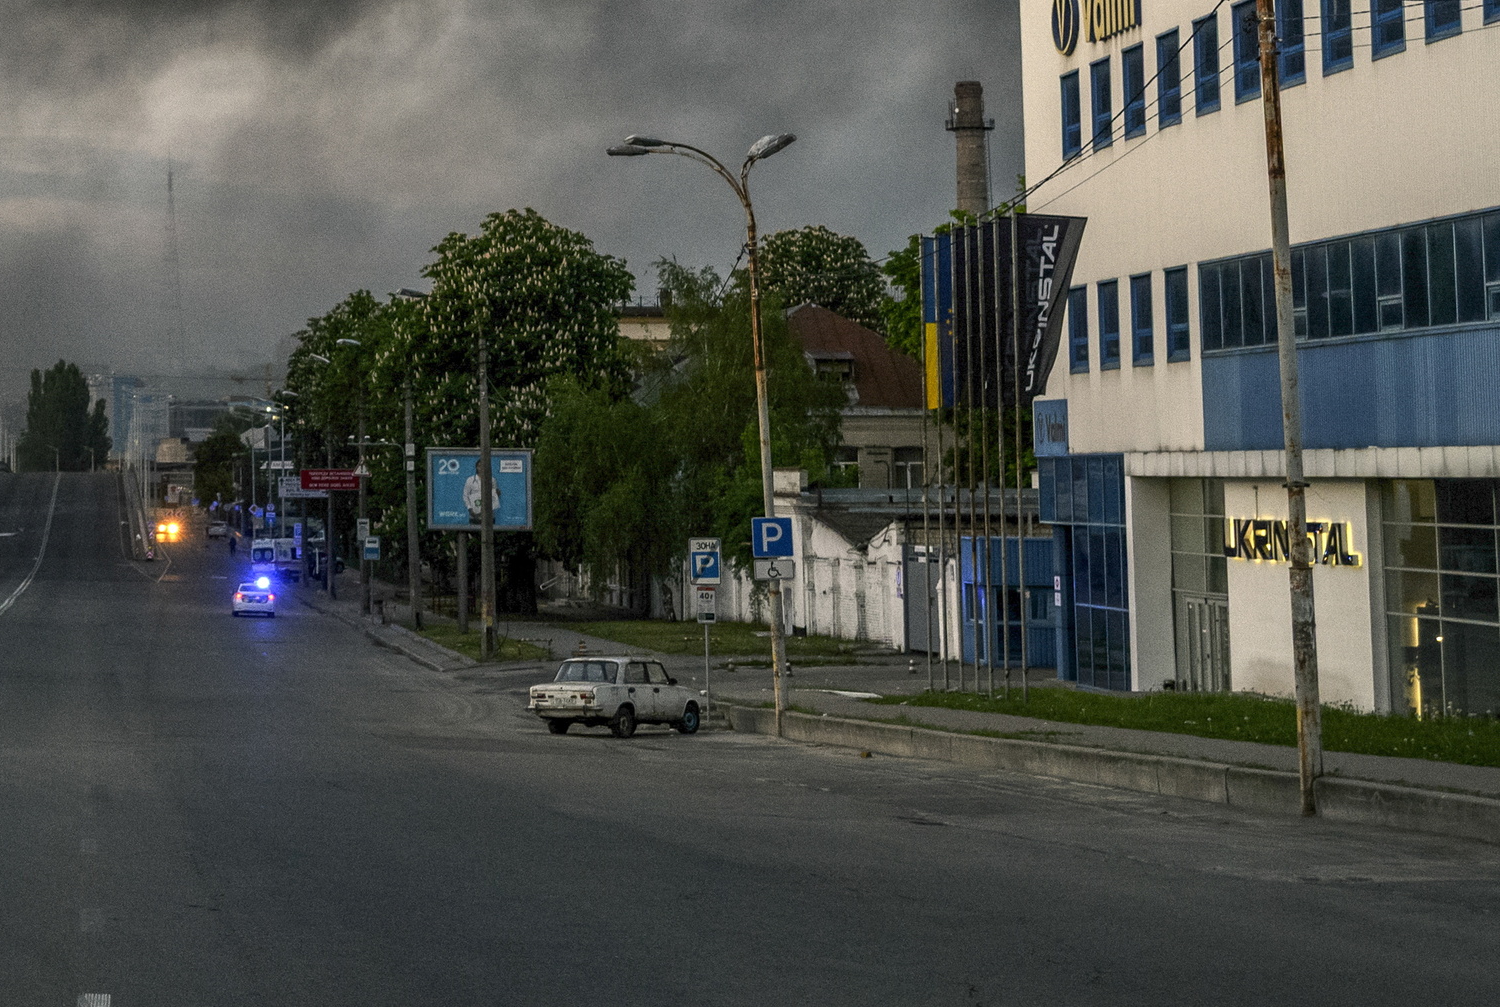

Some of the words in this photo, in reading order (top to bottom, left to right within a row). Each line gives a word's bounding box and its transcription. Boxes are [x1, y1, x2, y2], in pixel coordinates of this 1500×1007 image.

[696, 542, 715, 550] ЗОНА
[762, 523, 782, 552] P
[1224, 518, 1358, 565] UKRINTAL
[695, 555, 715, 575] P
